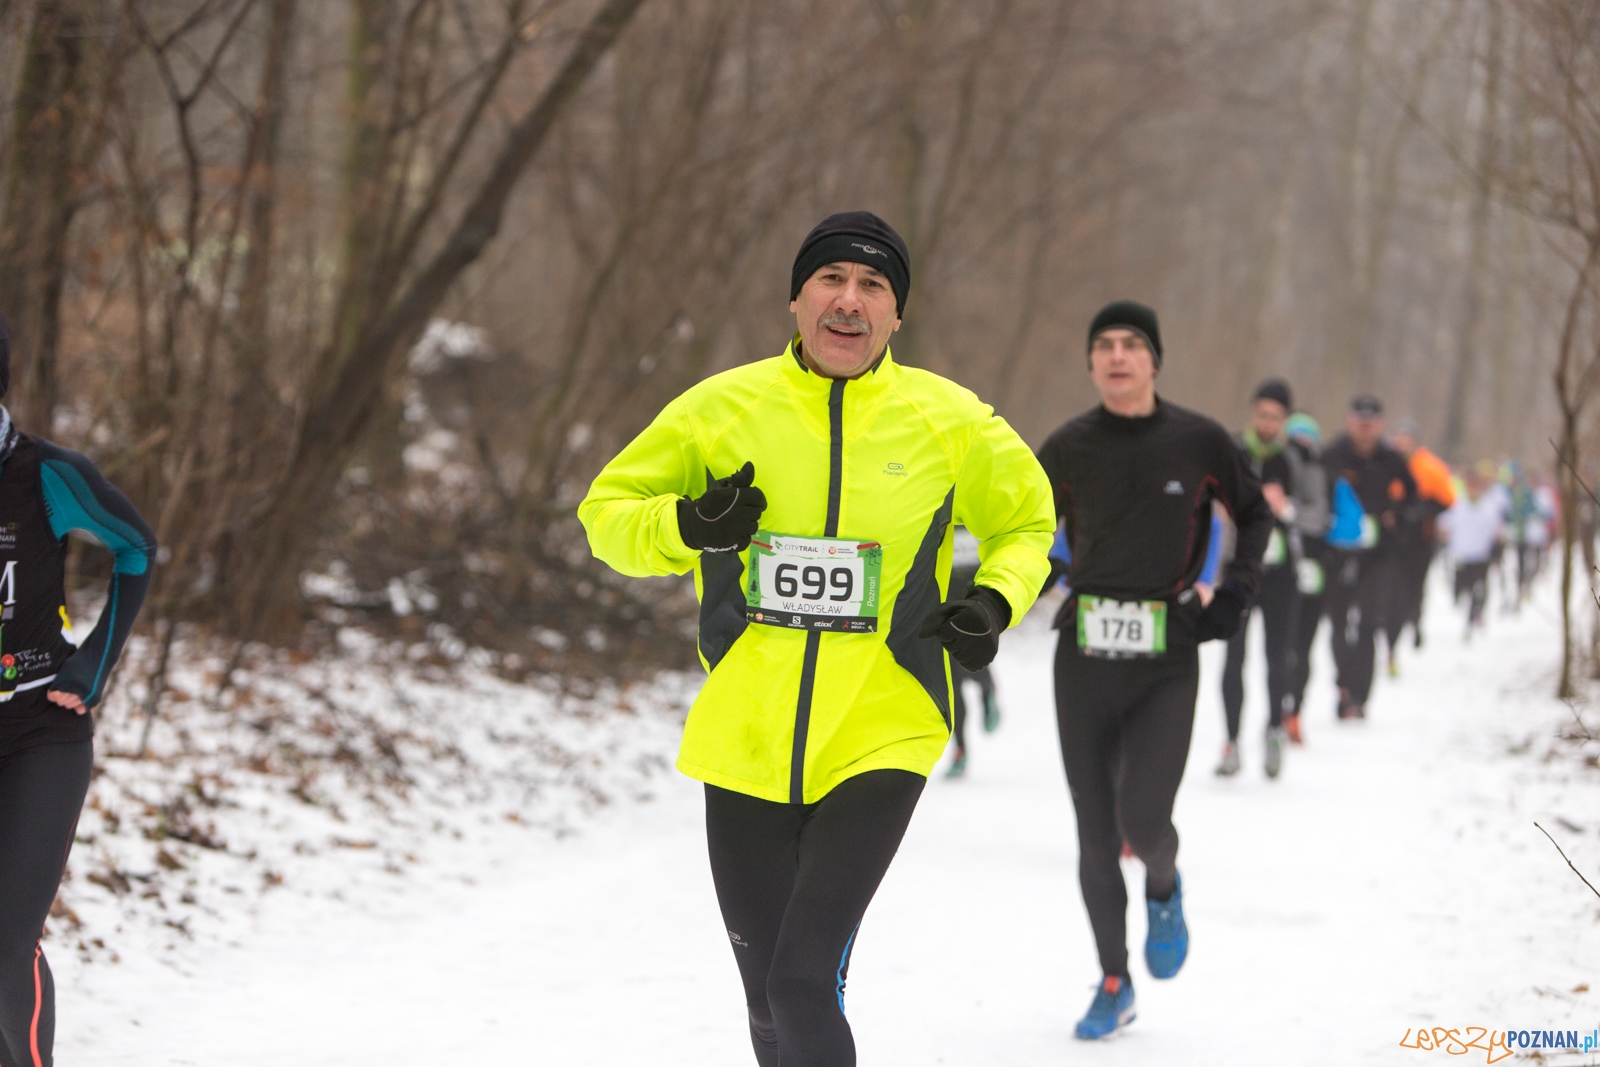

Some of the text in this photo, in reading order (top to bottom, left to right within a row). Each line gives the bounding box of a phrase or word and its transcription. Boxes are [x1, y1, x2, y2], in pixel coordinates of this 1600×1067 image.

[774, 563, 854, 602] 699
[866, 575, 876, 608] Poznań
[781, 601, 843, 615] WŁADYSŁAW
[1100, 617, 1143, 641] 178
